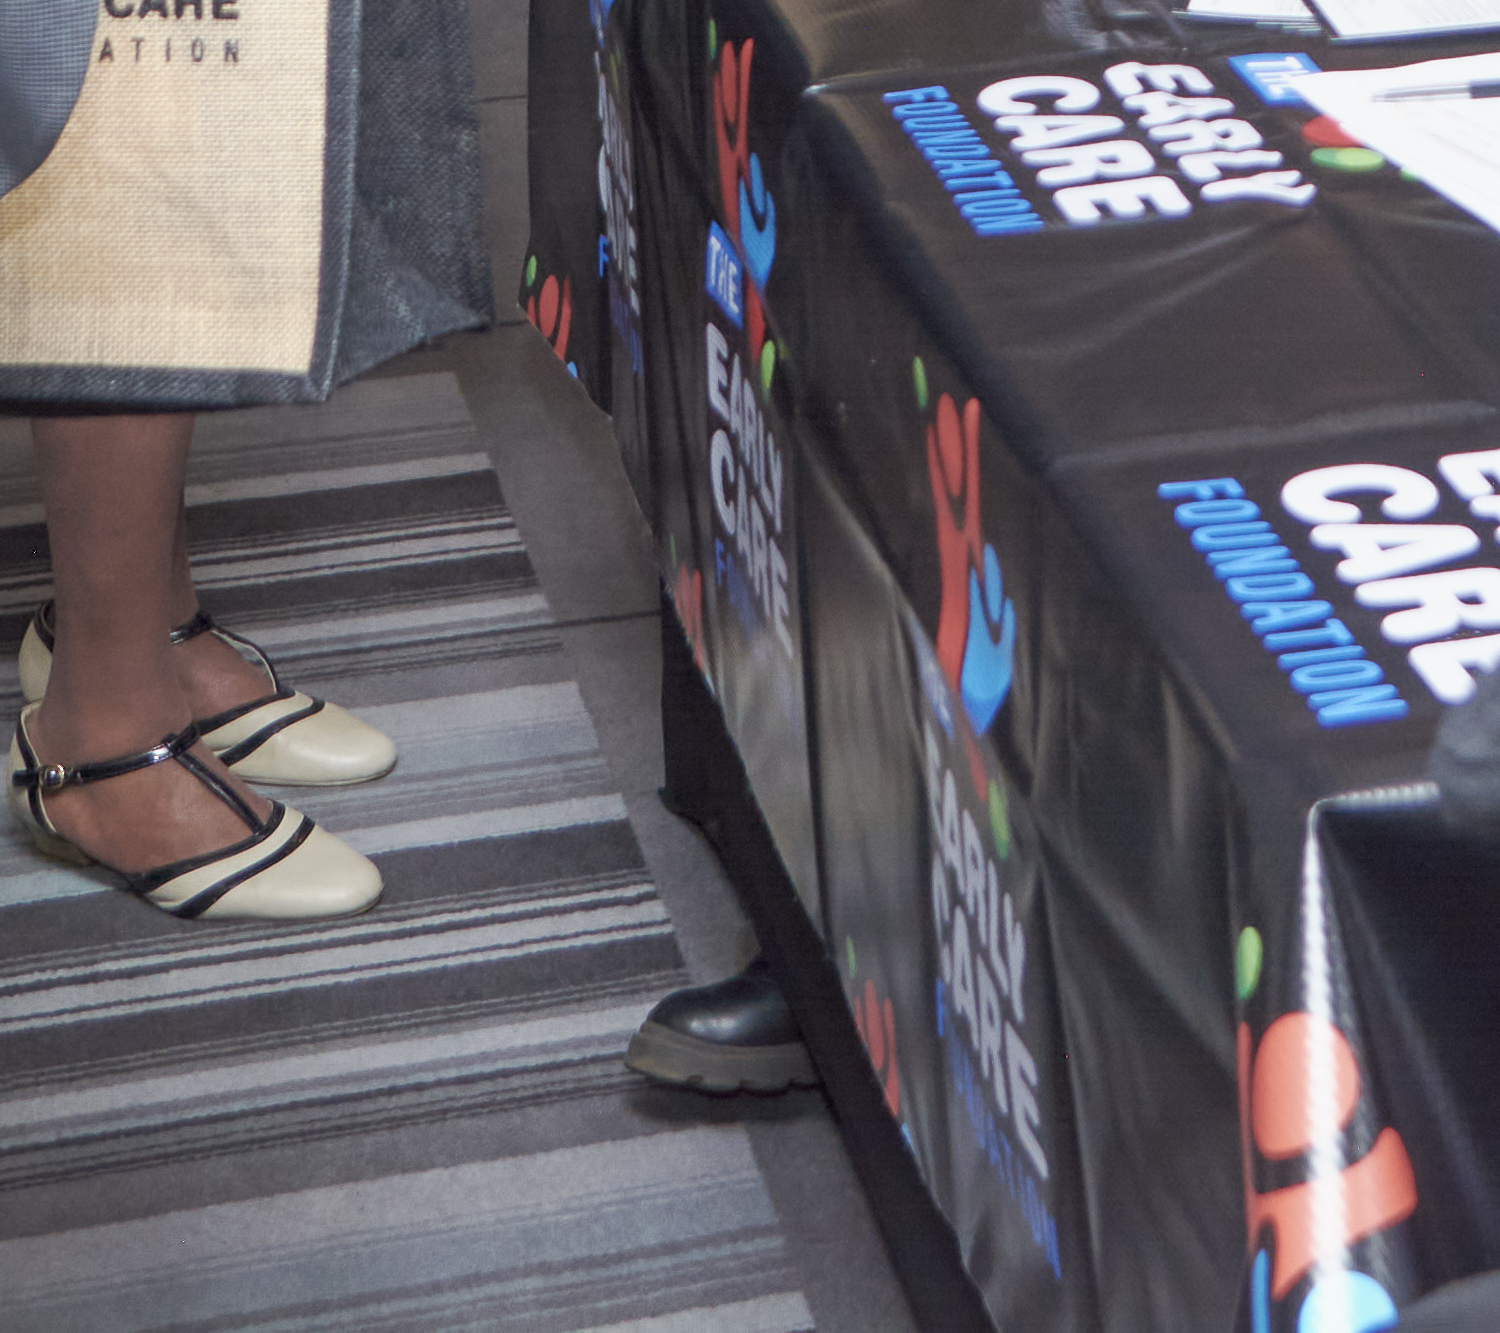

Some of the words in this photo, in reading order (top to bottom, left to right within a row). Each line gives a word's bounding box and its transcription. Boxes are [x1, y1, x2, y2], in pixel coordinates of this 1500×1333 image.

[881, 84, 1046, 237] FOUNDATION
[975, 74, 1194, 230] CARE
[1102, 60, 1319, 208] EARLY
[707, 235, 740, 316] THE
[709, 429, 794, 660] CARE
[1157, 476, 1410, 729] FOUNDATION
